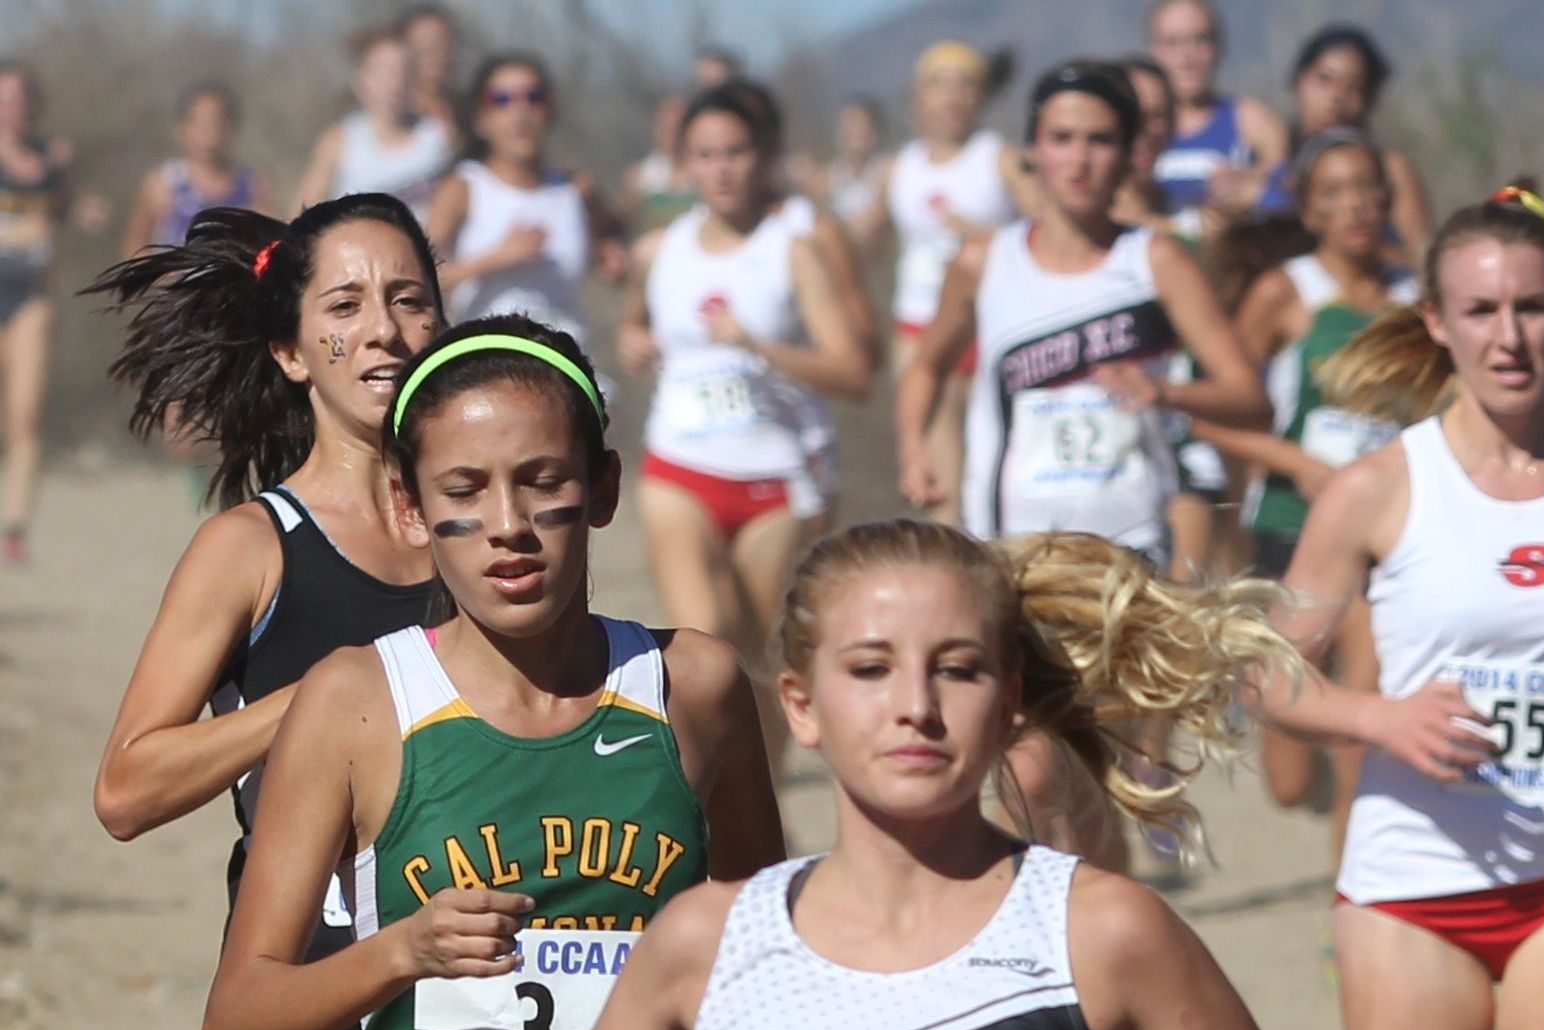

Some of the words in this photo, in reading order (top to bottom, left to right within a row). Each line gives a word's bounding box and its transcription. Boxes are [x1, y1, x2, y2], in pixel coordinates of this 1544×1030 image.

[1459, 664, 1519, 692] 2014
[402, 823, 523, 906] CAL
[540, 814, 685, 897] POLY
[536, 940, 633, 976] CCAA
